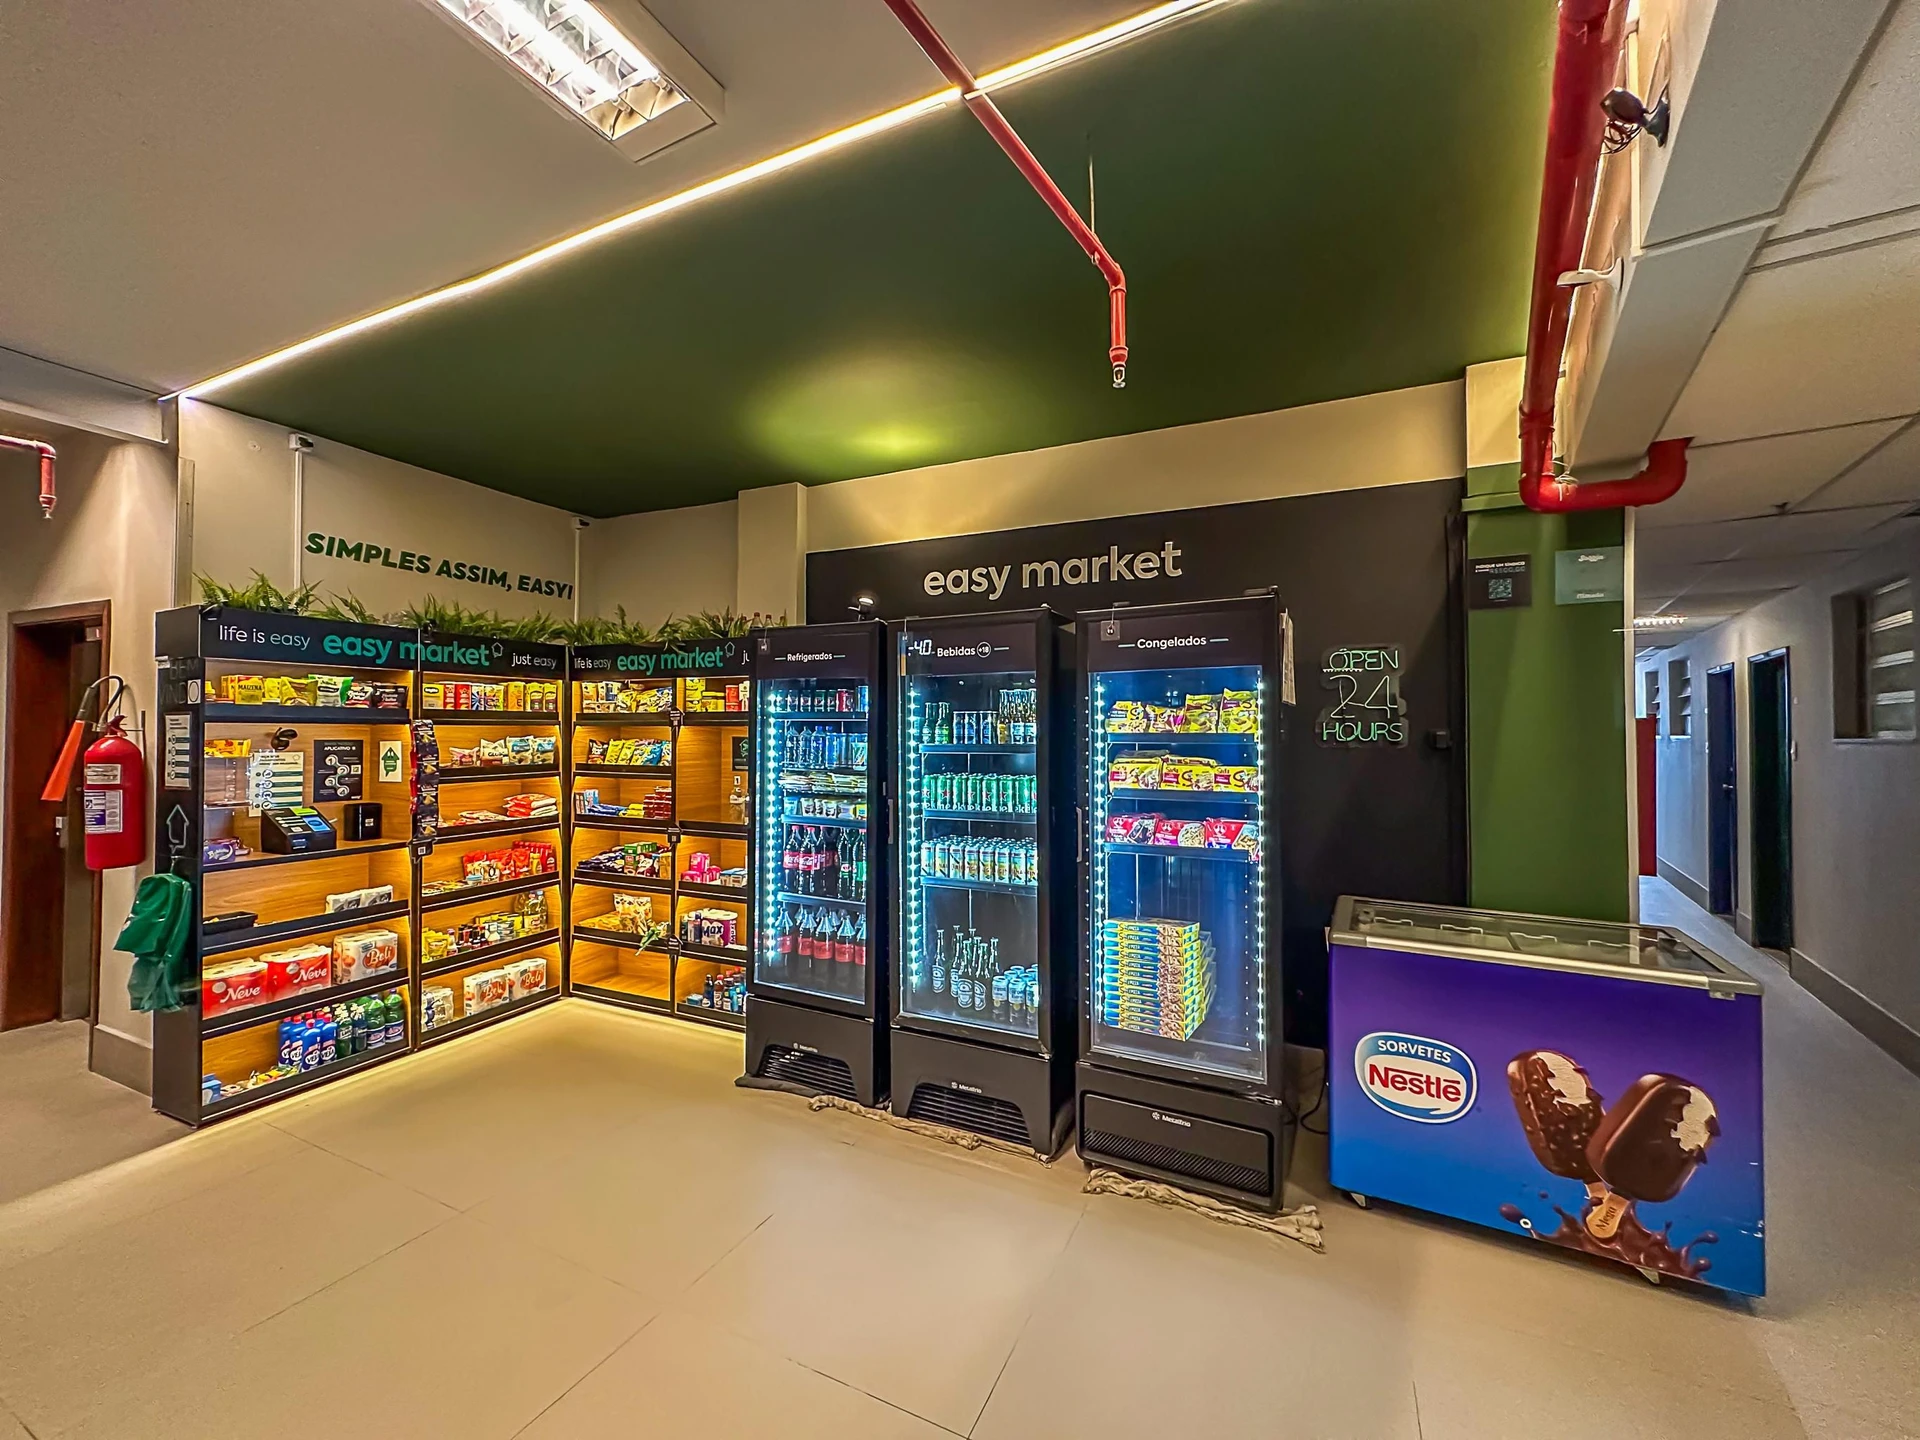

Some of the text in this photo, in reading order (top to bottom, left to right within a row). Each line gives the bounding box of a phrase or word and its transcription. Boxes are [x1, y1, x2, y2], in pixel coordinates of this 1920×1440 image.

[304, 532, 574, 600] SIMPLES ASSIM, EASY!
[924, 541, 1183, 600] easy market
[219, 624, 310, 650] life is easy
[1137, 636, 1207, 650] Congelados
[323, 634, 490, 667] easy market
[511, 653, 557, 669] just easy
[617, 646, 724, 675] easy market
[787, 652, 832, 662] Refrigerados
[937, 646, 976, 657] Bebidas
[1329, 649, 1398, 670] OPEN
[574, 657, 612, 670] life is easy
[238, 683, 262, 691] MAIZENA
[1329, 674, 1398, 719] 24
[1323, 721, 1403, 742] HOURS
[293, 966, 328, 983] Neve
[220, 985, 261, 1004] Neve
[1378, 1040, 1452, 1063] SORVETES
[1369, 1063, 1461, 1102] Nestlé
